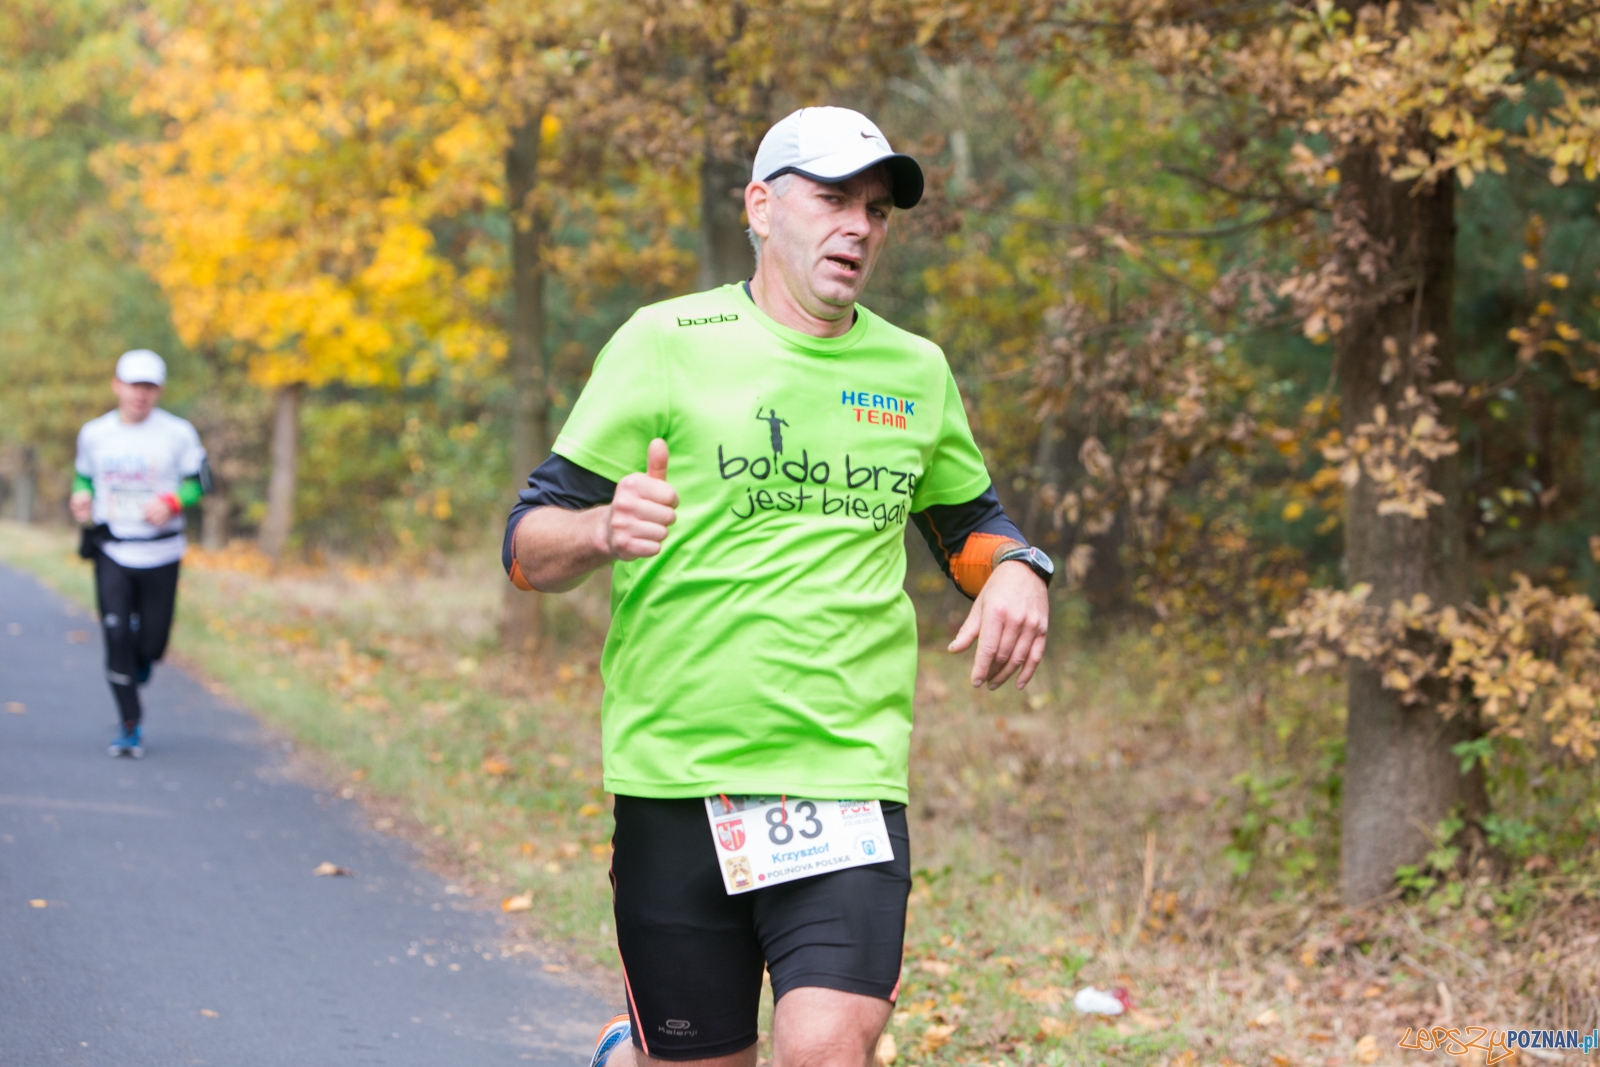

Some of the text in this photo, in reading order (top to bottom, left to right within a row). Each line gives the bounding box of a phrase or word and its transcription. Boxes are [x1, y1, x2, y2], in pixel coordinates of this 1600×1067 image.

[677, 313, 739, 327] bodo
[842, 390, 915, 416] HERNIK
[852, 408, 907, 431] TEAM
[731, 485, 813, 519] jest
[765, 801, 823, 846] 83
[771, 842, 831, 864] Krzysztof
[767, 855, 851, 880] POLINOVA POLSKA
